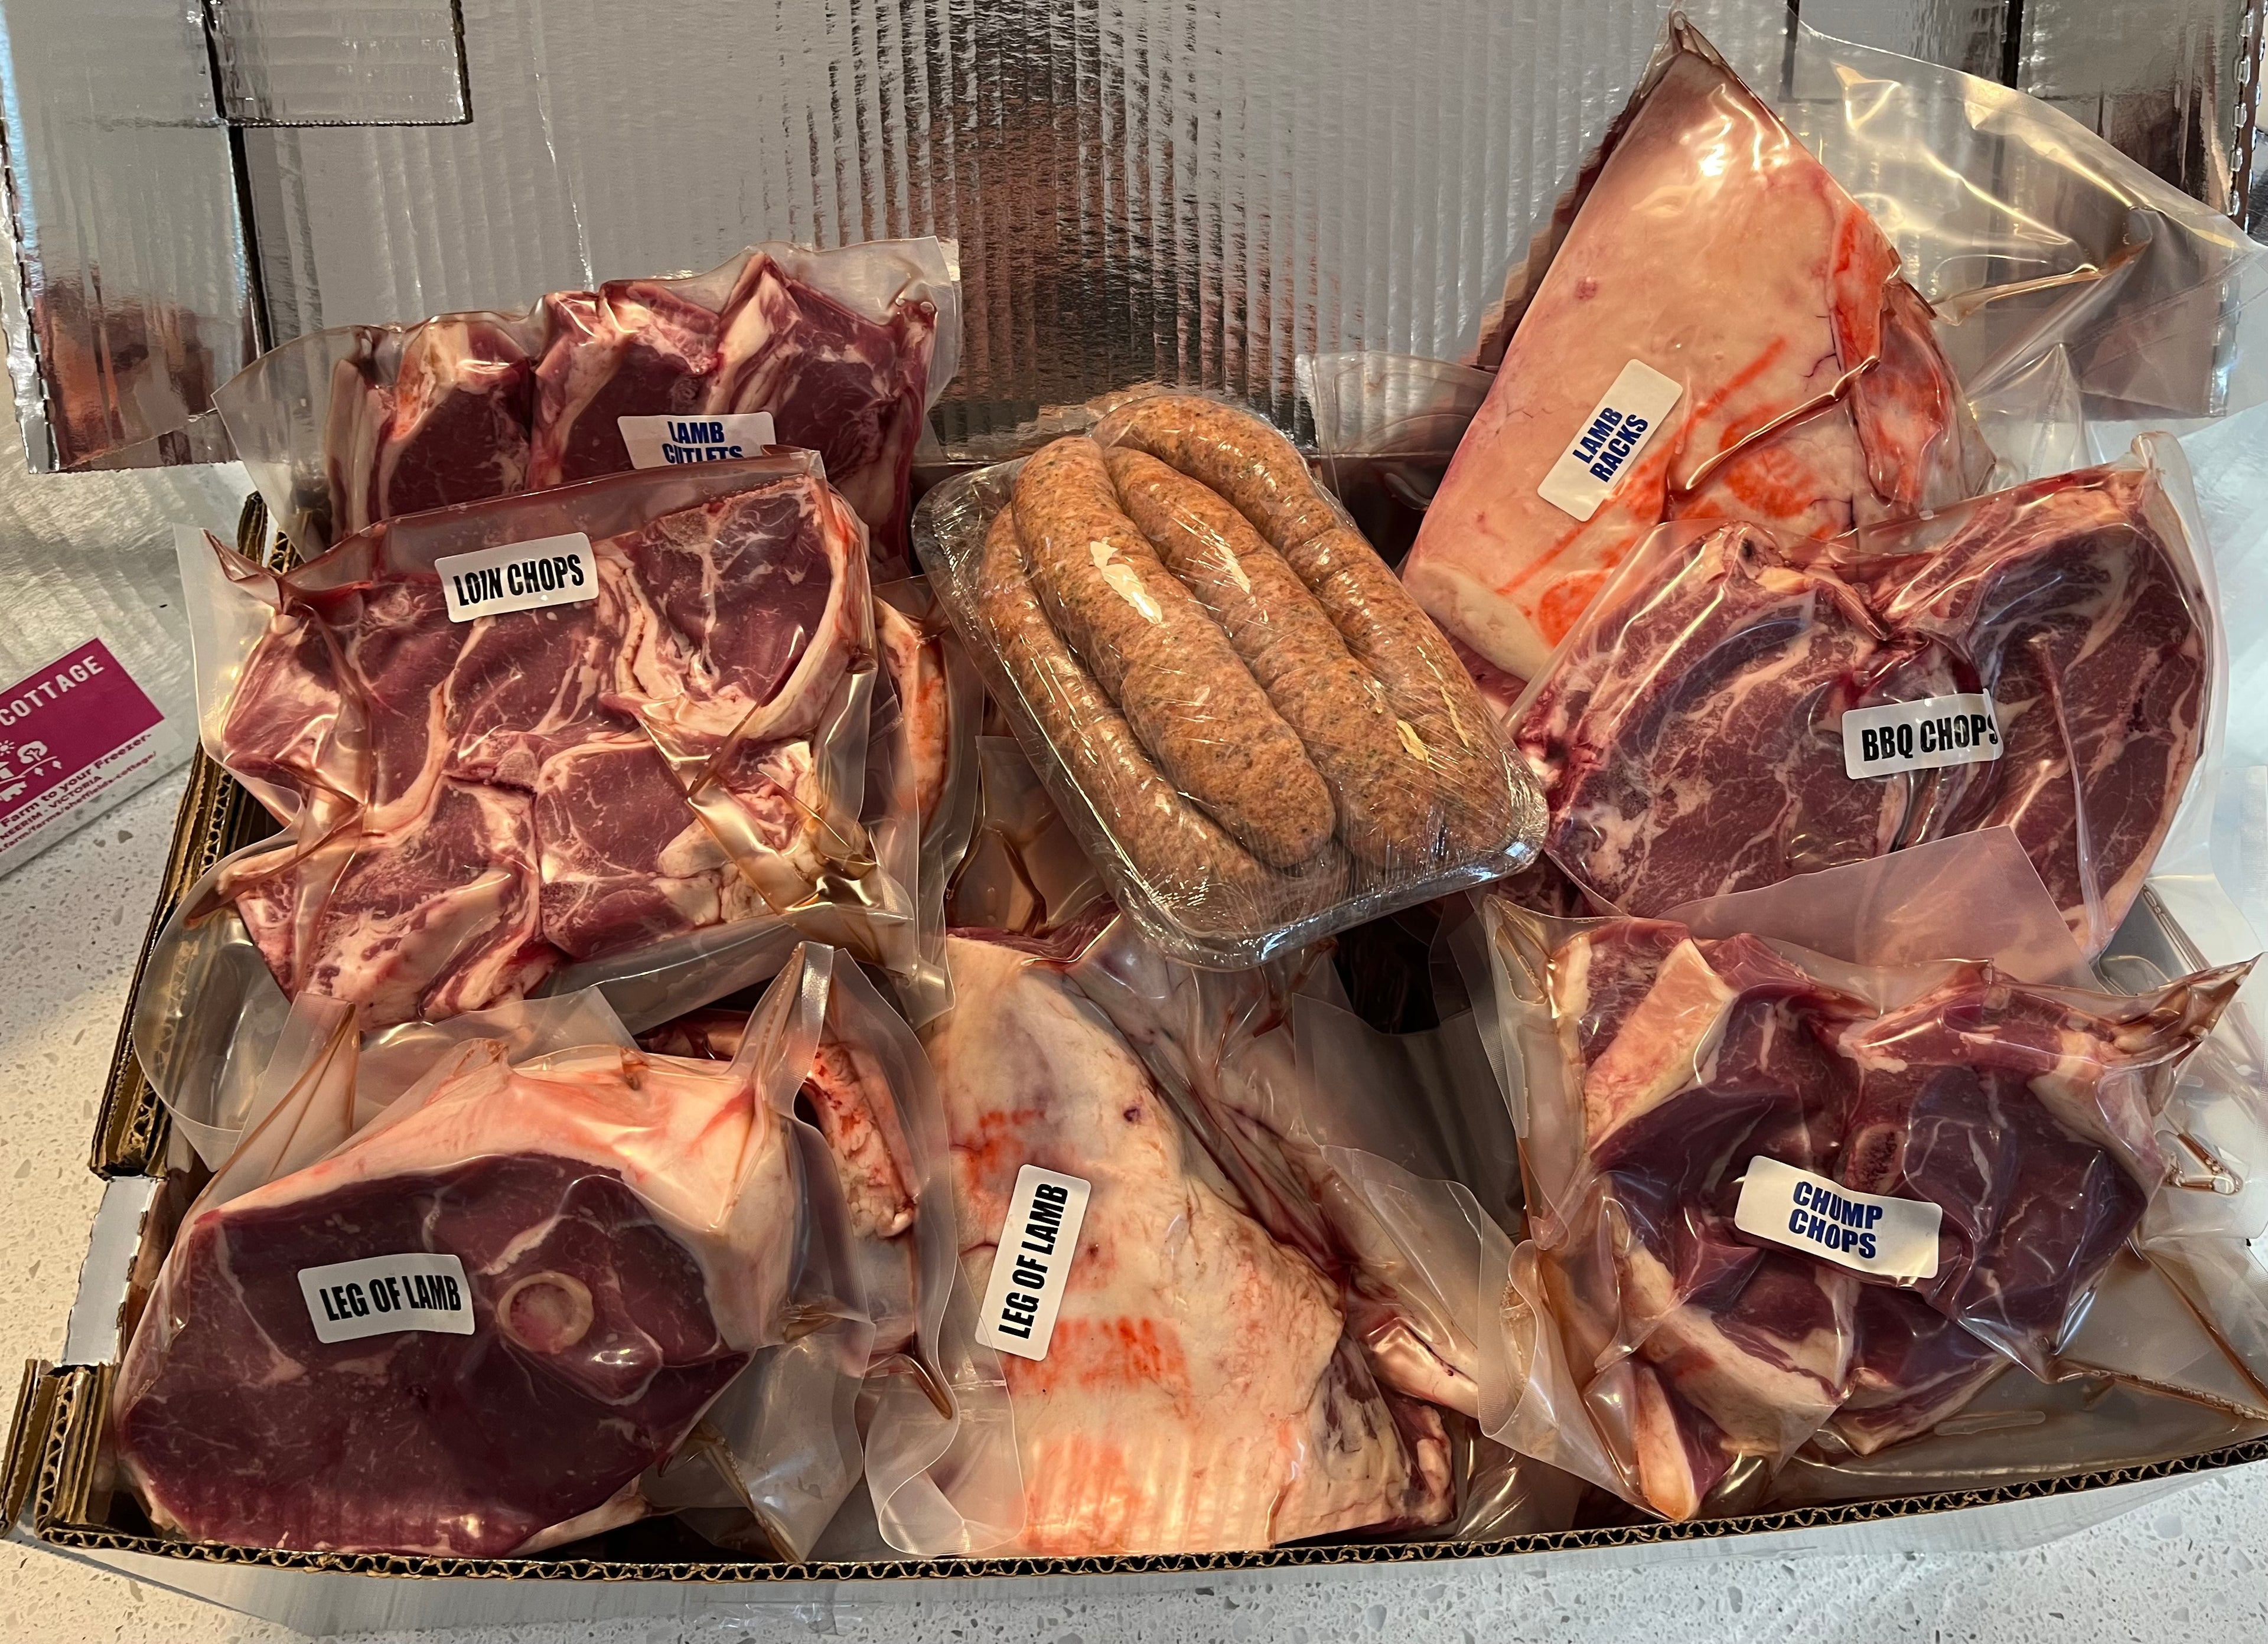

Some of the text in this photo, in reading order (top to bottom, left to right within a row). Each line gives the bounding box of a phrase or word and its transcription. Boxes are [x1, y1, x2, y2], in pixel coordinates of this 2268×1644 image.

[667, 421, 725, 443] LAMB
[1572, 407, 1622, 464] LAMB
[1589, 415, 1648, 482] RACKS
[453, 554, 584, 606] LOIN CHOPS
[0, 655, 104, 726] COTTAGE
[1862, 724, 1913, 761] BBQ
[0, 803, 40, 827] Farm
[41, 791, 57, 801] to
[59, 768, 91, 792] your
[0, 812, 43, 840] NEERIM
[48, 776, 102, 808] VICTORIA
[1793, 1181, 1883, 1229] CHUMP
[998, 1183, 1068, 1339] LEG OF LAMB
[1788, 1209, 1876, 1259] CHOPS
[320, 1275, 461, 1321] LEG OF LAMB
